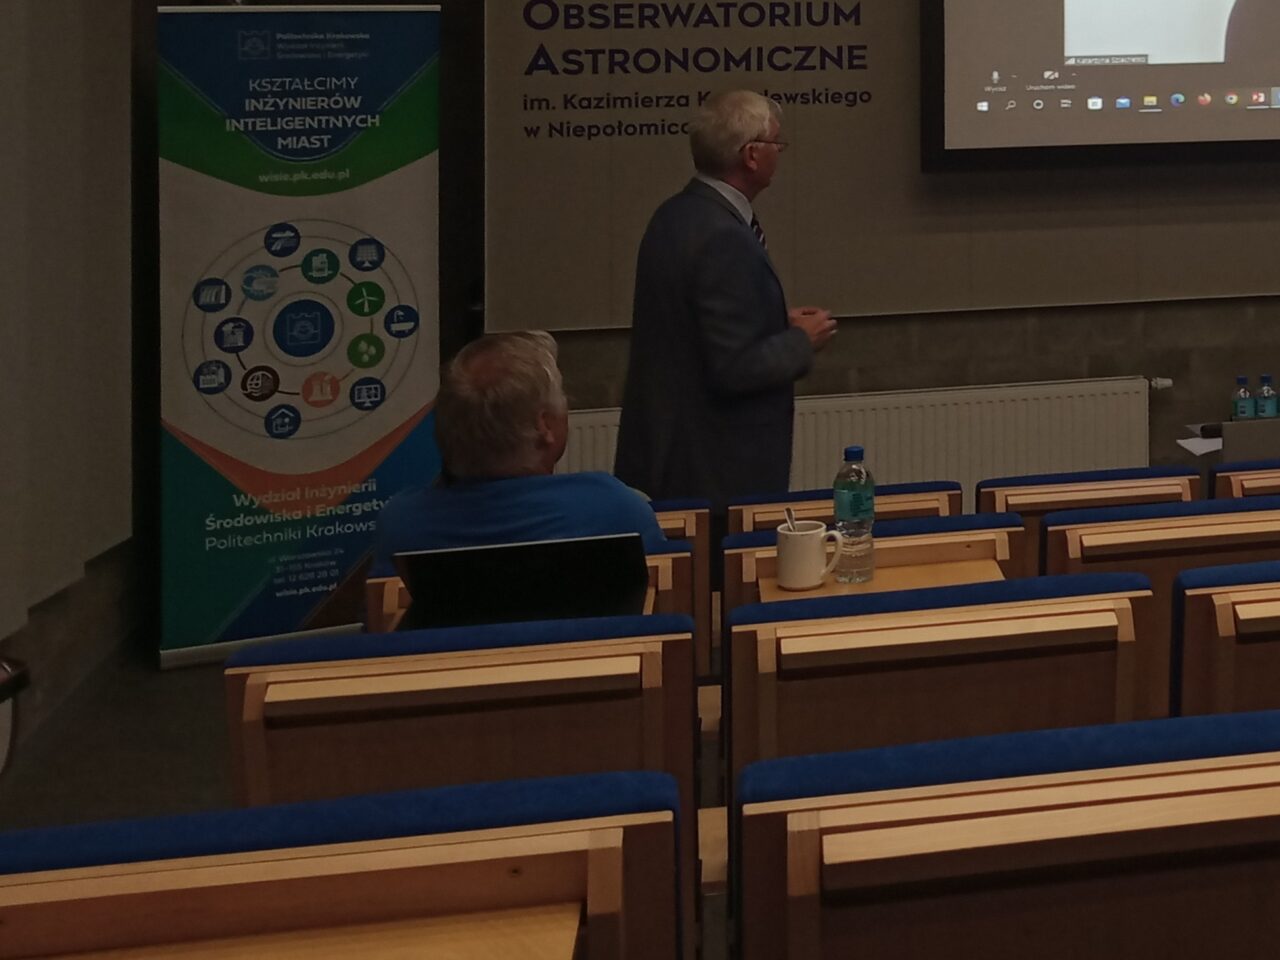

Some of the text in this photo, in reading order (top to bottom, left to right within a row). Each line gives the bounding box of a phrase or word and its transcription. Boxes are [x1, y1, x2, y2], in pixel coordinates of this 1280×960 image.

[524, 43, 869, 76] ASTRONOMICZNE
[249, 76, 360, 92] KSZTAŁCIMY
[244, 92, 363, 112] INŻYNIERÓW
[522, 93, 556, 110] im.
[563, 90, 690, 109] Kazimierza
[225, 114, 382, 131] INTELIGENTNYCH
[524, 124, 541, 138] w
[276, 134, 333, 150] MIAST
[205, 506, 302, 531] Środowiska
[307, 506, 313, 518] i
[205, 527, 302, 551] Politechniki
